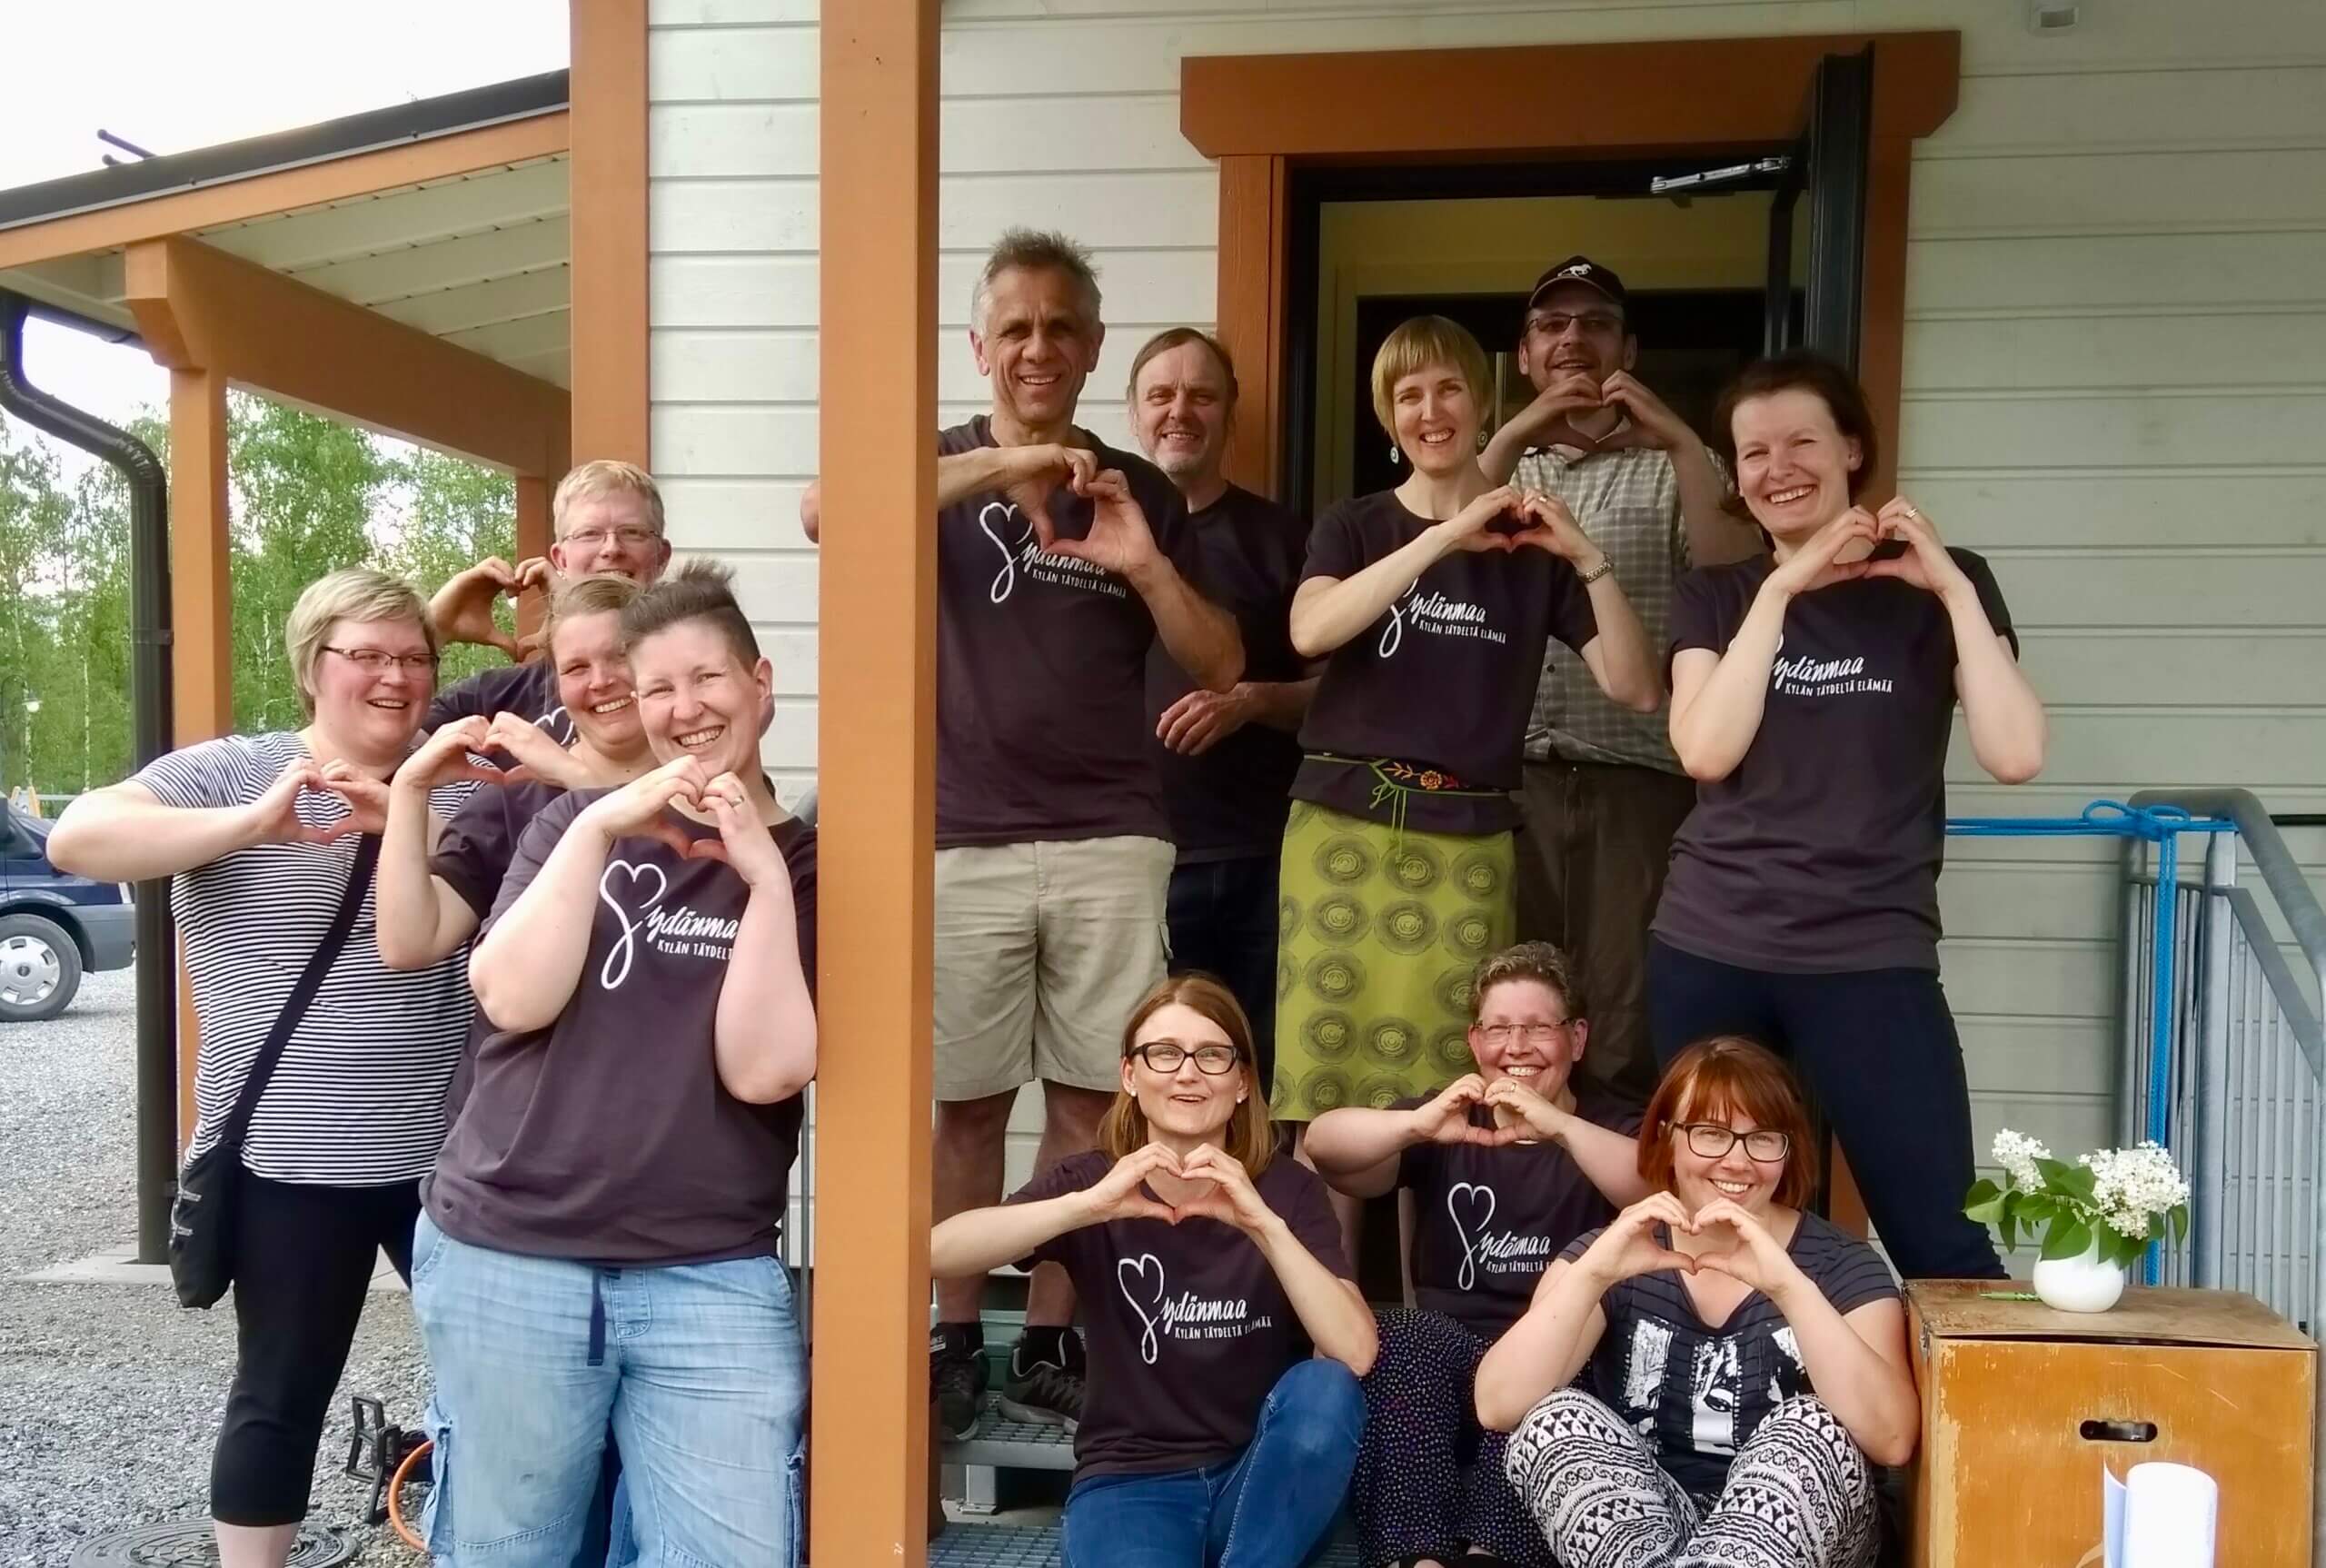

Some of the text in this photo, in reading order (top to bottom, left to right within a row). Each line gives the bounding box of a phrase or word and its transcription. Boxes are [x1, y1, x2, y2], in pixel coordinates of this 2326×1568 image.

[1032, 569, 1059, 583] KYLÄN
[1418, 619, 1443, 635] KYLÄN
[1445, 623, 1478, 637] TÄYDELTÄ
[1784, 679, 1893, 697] KYLÄN TÄYDELTÄ ELÄMÄÄ
[657, 938, 734, 960] KYLÄN TÄYDELT
[1509, 1260, 1544, 1273] TÄYDELTÄ
[1175, 1326, 1201, 1340] KYLÄN
[1204, 1325, 1243, 1339] TÄYDELTÄ
